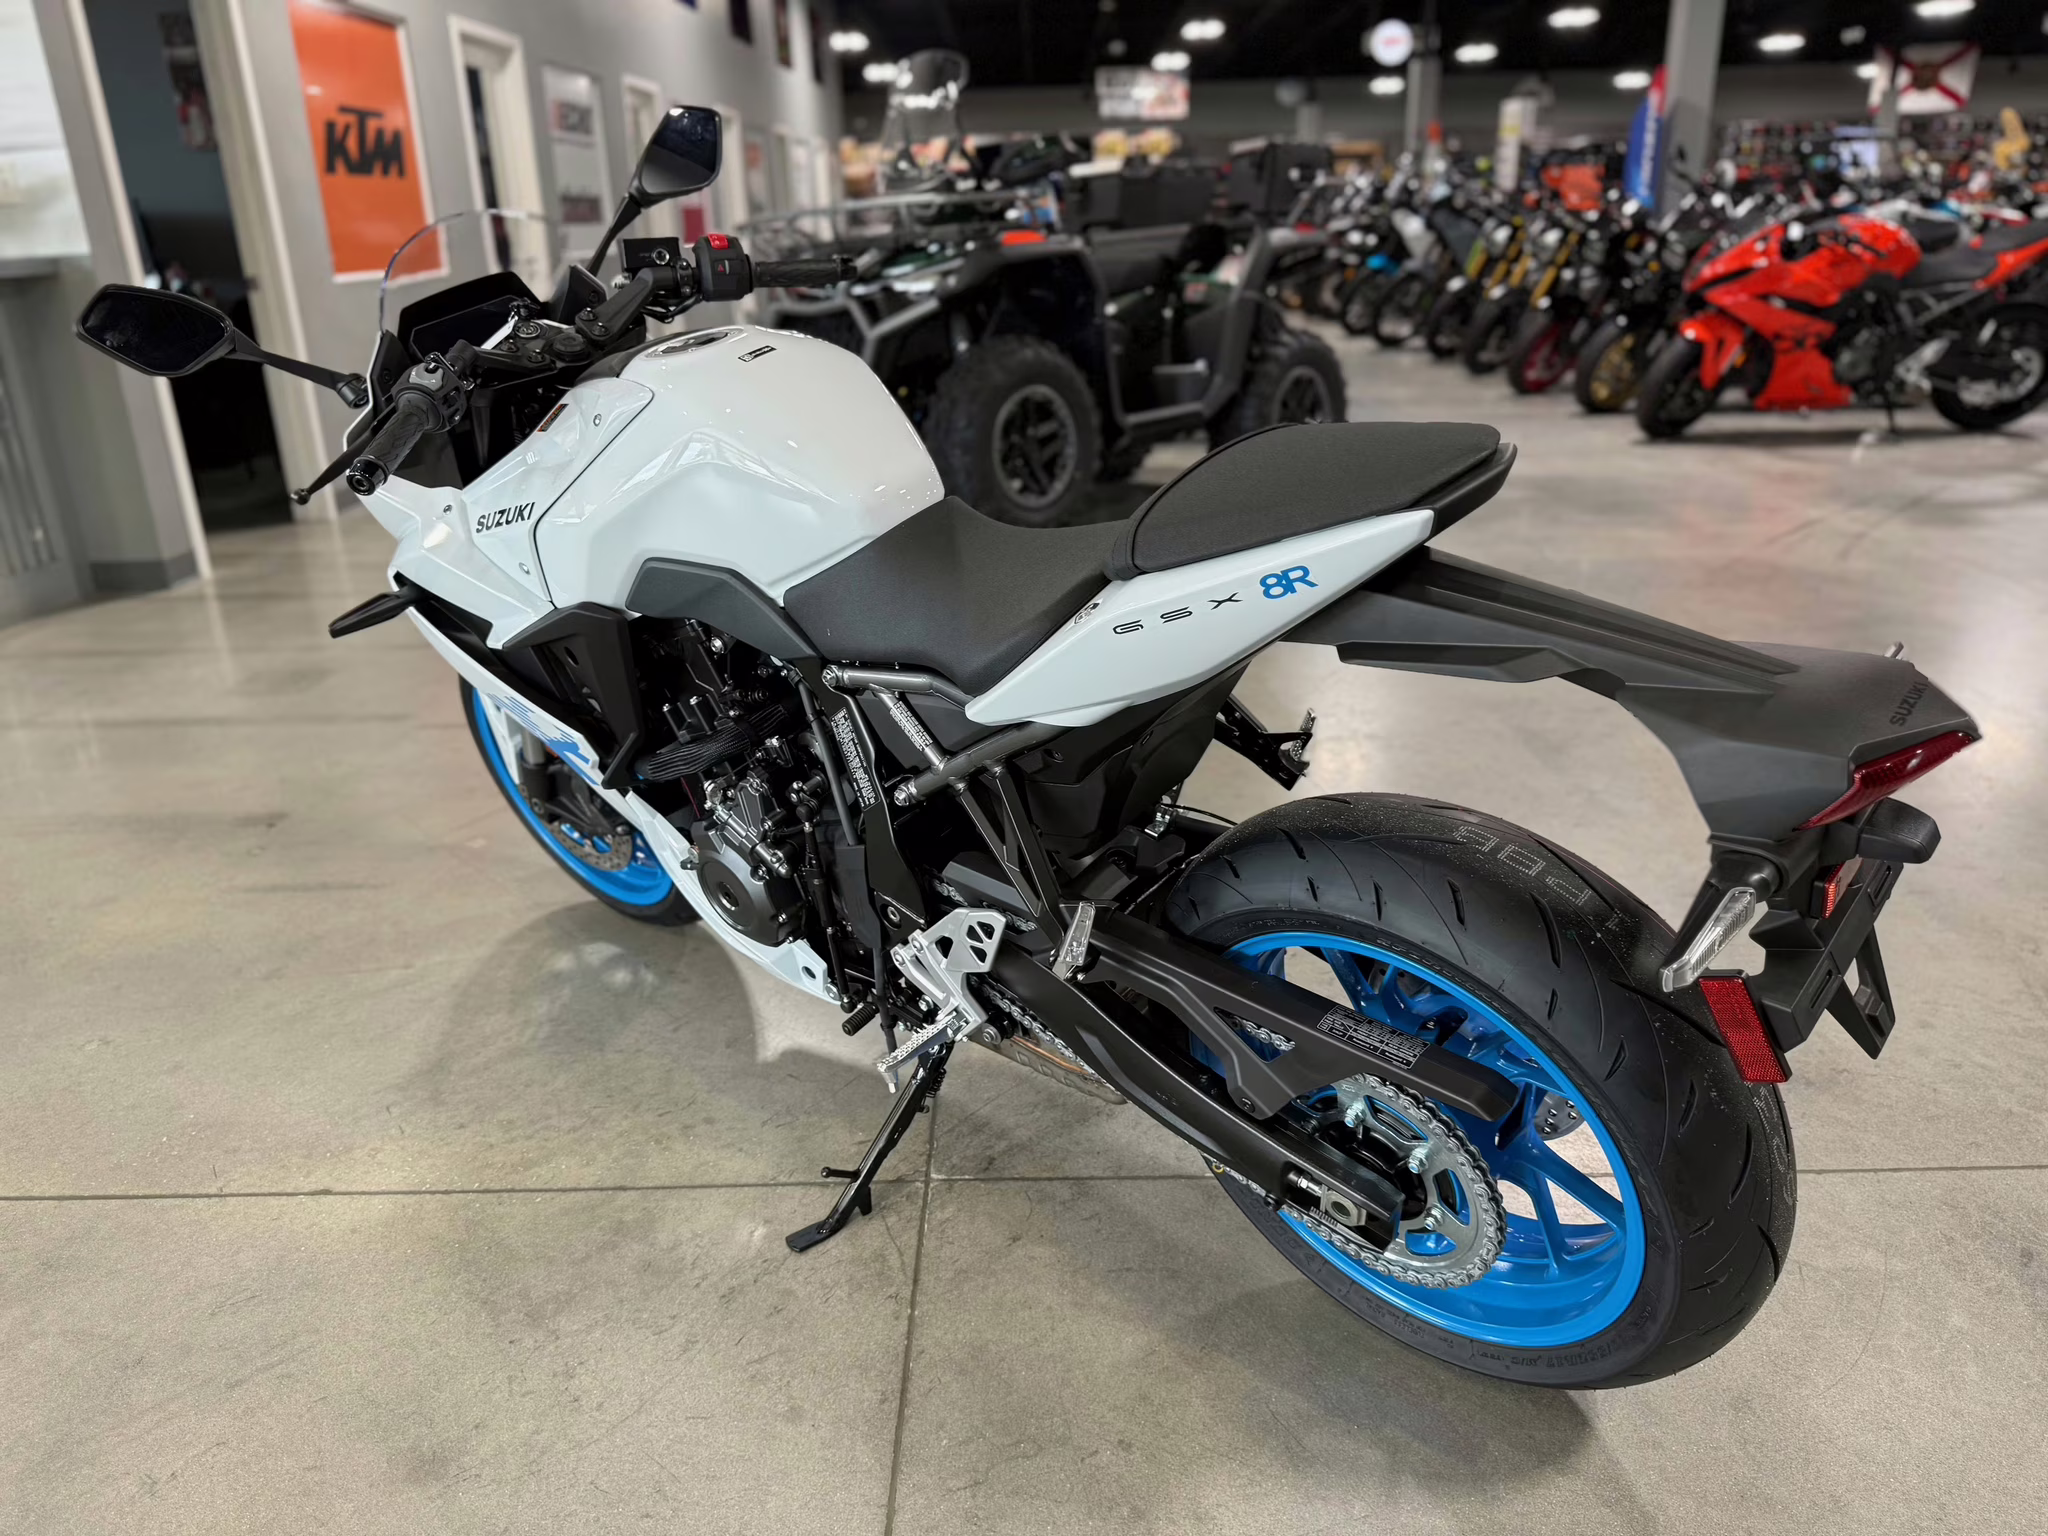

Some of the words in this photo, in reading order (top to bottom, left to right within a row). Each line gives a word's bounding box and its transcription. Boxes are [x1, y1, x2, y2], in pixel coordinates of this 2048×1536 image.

[325, 105, 405, 179] KTM
[476, 501, 536, 534] SUZUKI
[1112, 591, 1244, 635] GSX
[1259, 565, 1319, 600] 8R
[1888, 681, 1929, 727] SUZUKI
